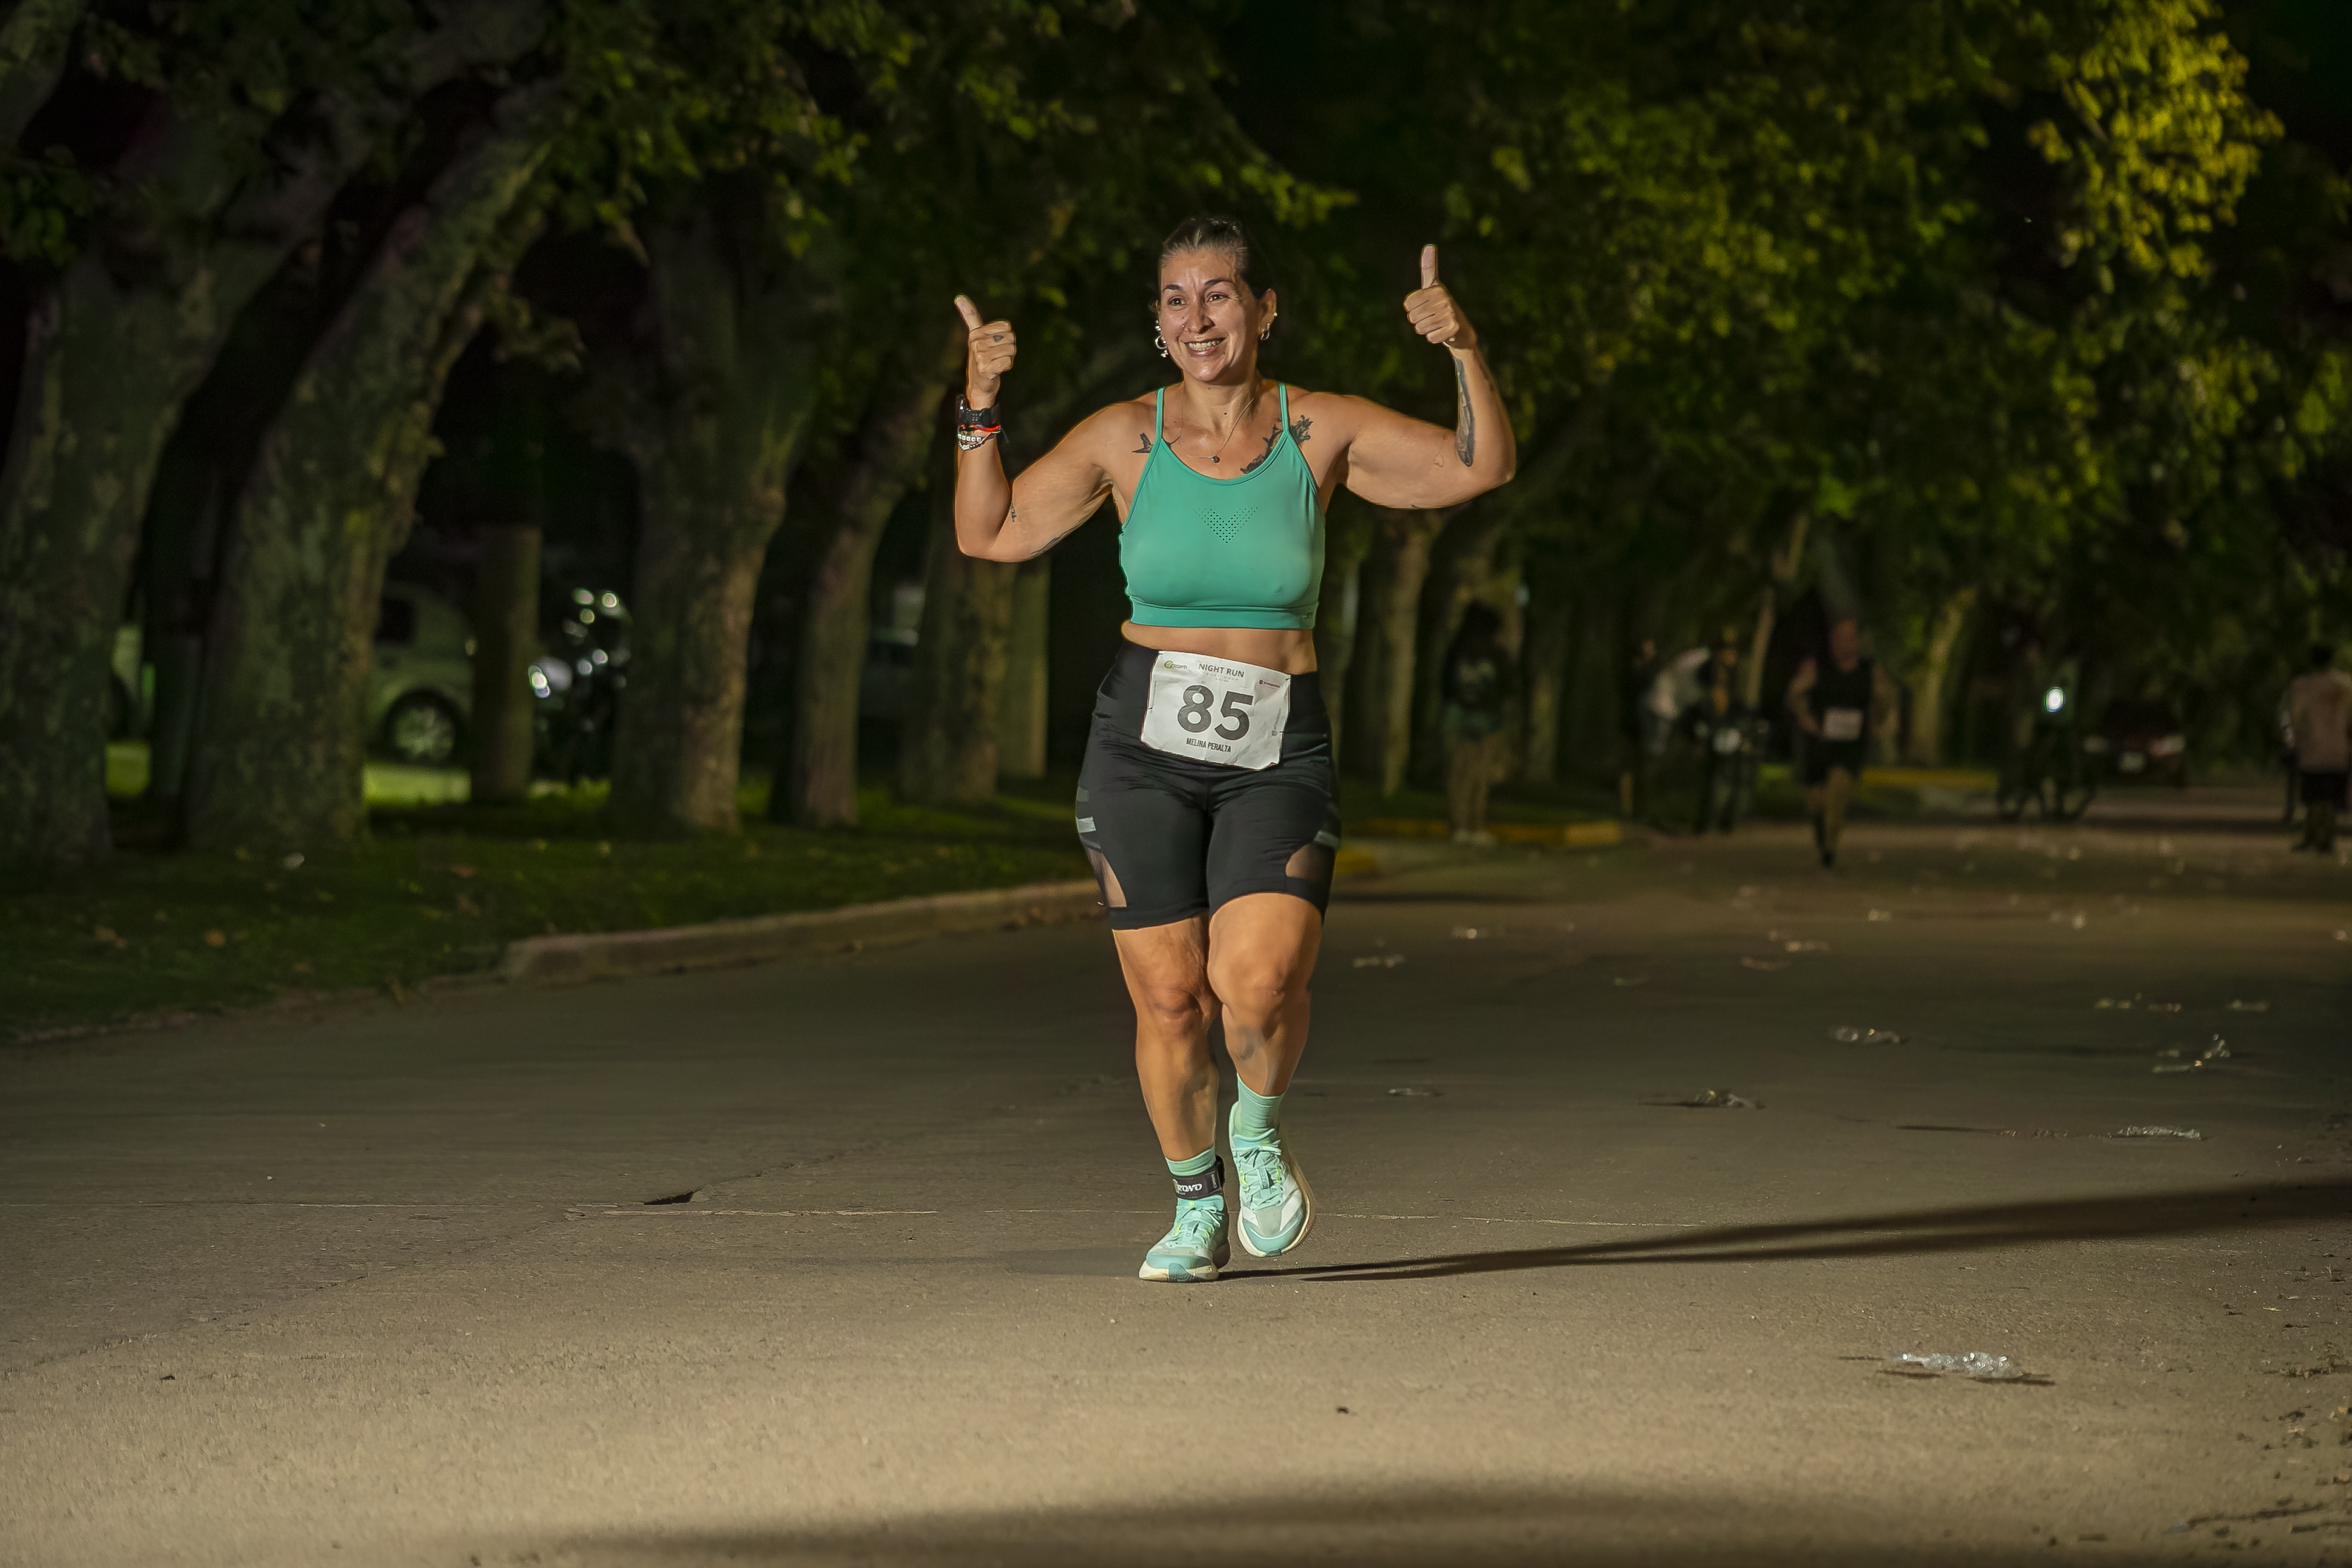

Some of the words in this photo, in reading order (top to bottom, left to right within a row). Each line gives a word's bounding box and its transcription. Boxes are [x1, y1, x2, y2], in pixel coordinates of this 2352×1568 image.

[1198, 663, 1225, 674] NIGHT
[1226, 668, 1245, 678] RUN
[1177, 685, 1254, 741] 85
[1186, 738, 1207, 748] MELINA
[1207, 742, 1231, 752] PERALTA
